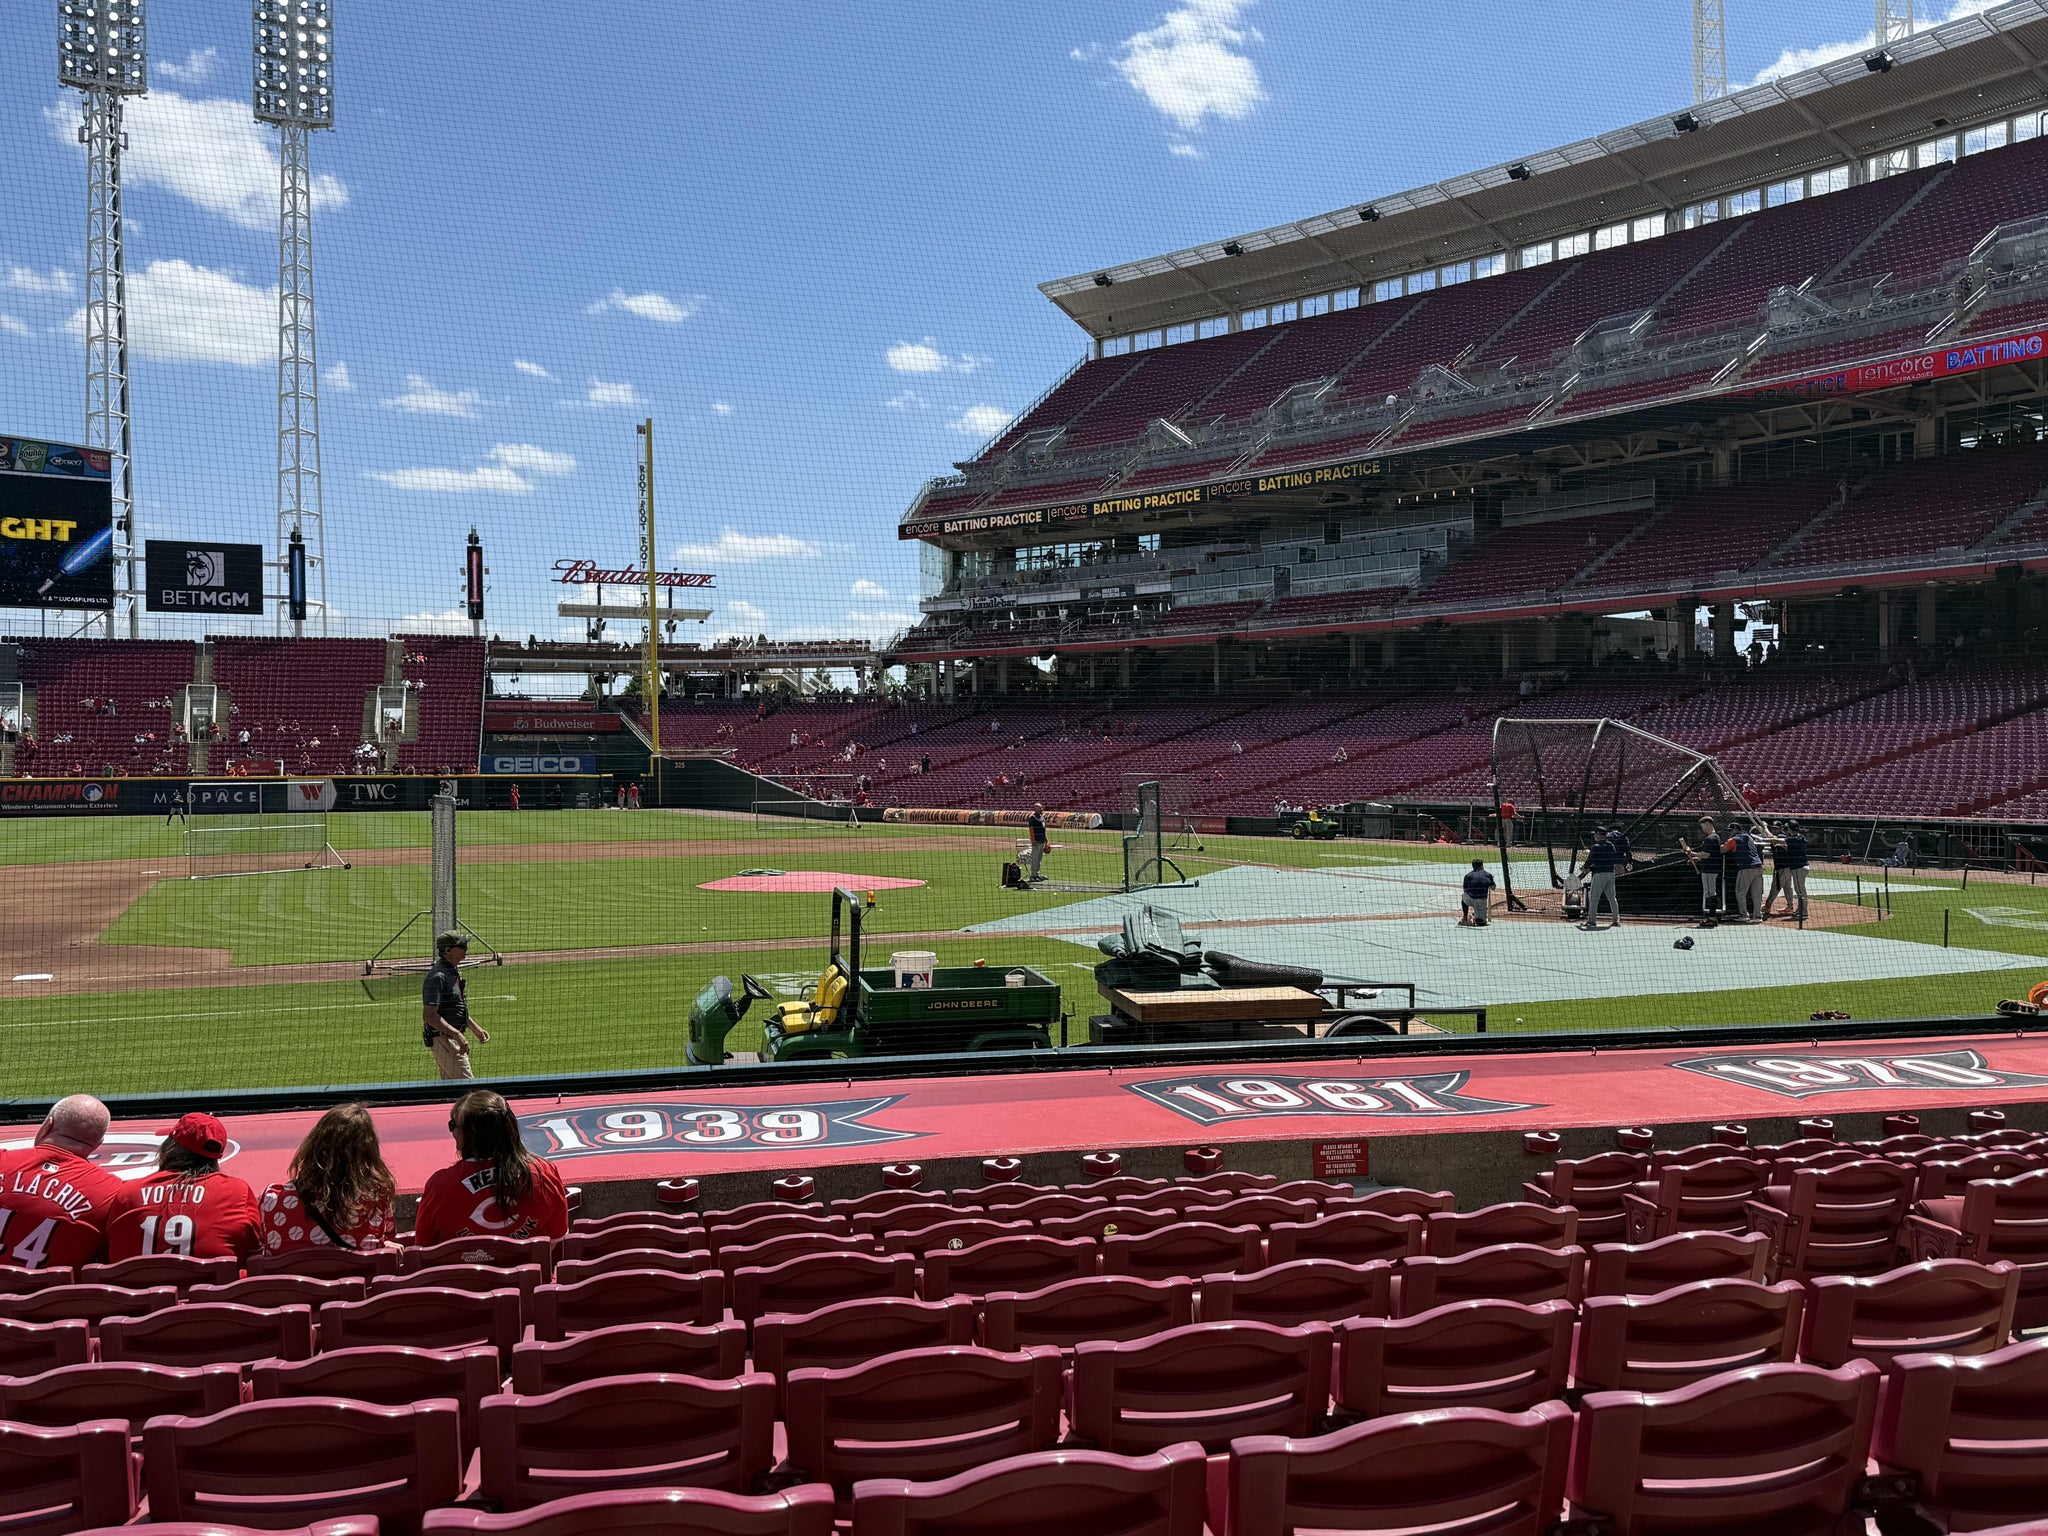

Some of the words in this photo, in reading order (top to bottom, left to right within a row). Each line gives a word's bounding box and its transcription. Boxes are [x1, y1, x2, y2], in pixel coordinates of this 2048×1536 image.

[1946, 336, 2042, 370] BATTING
[1864, 356, 1934, 380] encore
[1210, 480, 1252, 496] encore
[1258, 471, 1312, 492] BATTING
[1315, 461, 1381, 483] PRACTICE
[1051, 503, 1088, 518] encore
[1093, 498, 1141, 515] BATTING
[1144, 489, 1201, 509] PRACTICE
[0, 516, 77, 542] GHT
[905, 522, 939, 535] encore
[943, 517, 988, 533] BATTING
[990, 511, 1042, 528] PRACTICE
[162, 589, 249, 607] BETMGM
[971, 597, 1016, 609] handlebar
[534, 718, 595, 729] Budweiser
[493, 757, 581, 773] GEICO
[349, 783, 397, 800] TWC
[909, 810, 939, 821] GORILLA
[941, 810, 959, 821] GLUE
[928, 1001, 959, 1009] JOHN
[961, 1000, 998, 1008] DEERE
[1708, 1058, 2002, 1089] 1970
[1168, 1079, 1456, 1114] 1961
[530, 1108, 826, 1152] 1939
[140, 1183, 205, 1205] VOTTO
[140, 1215, 195, 1256] 19
